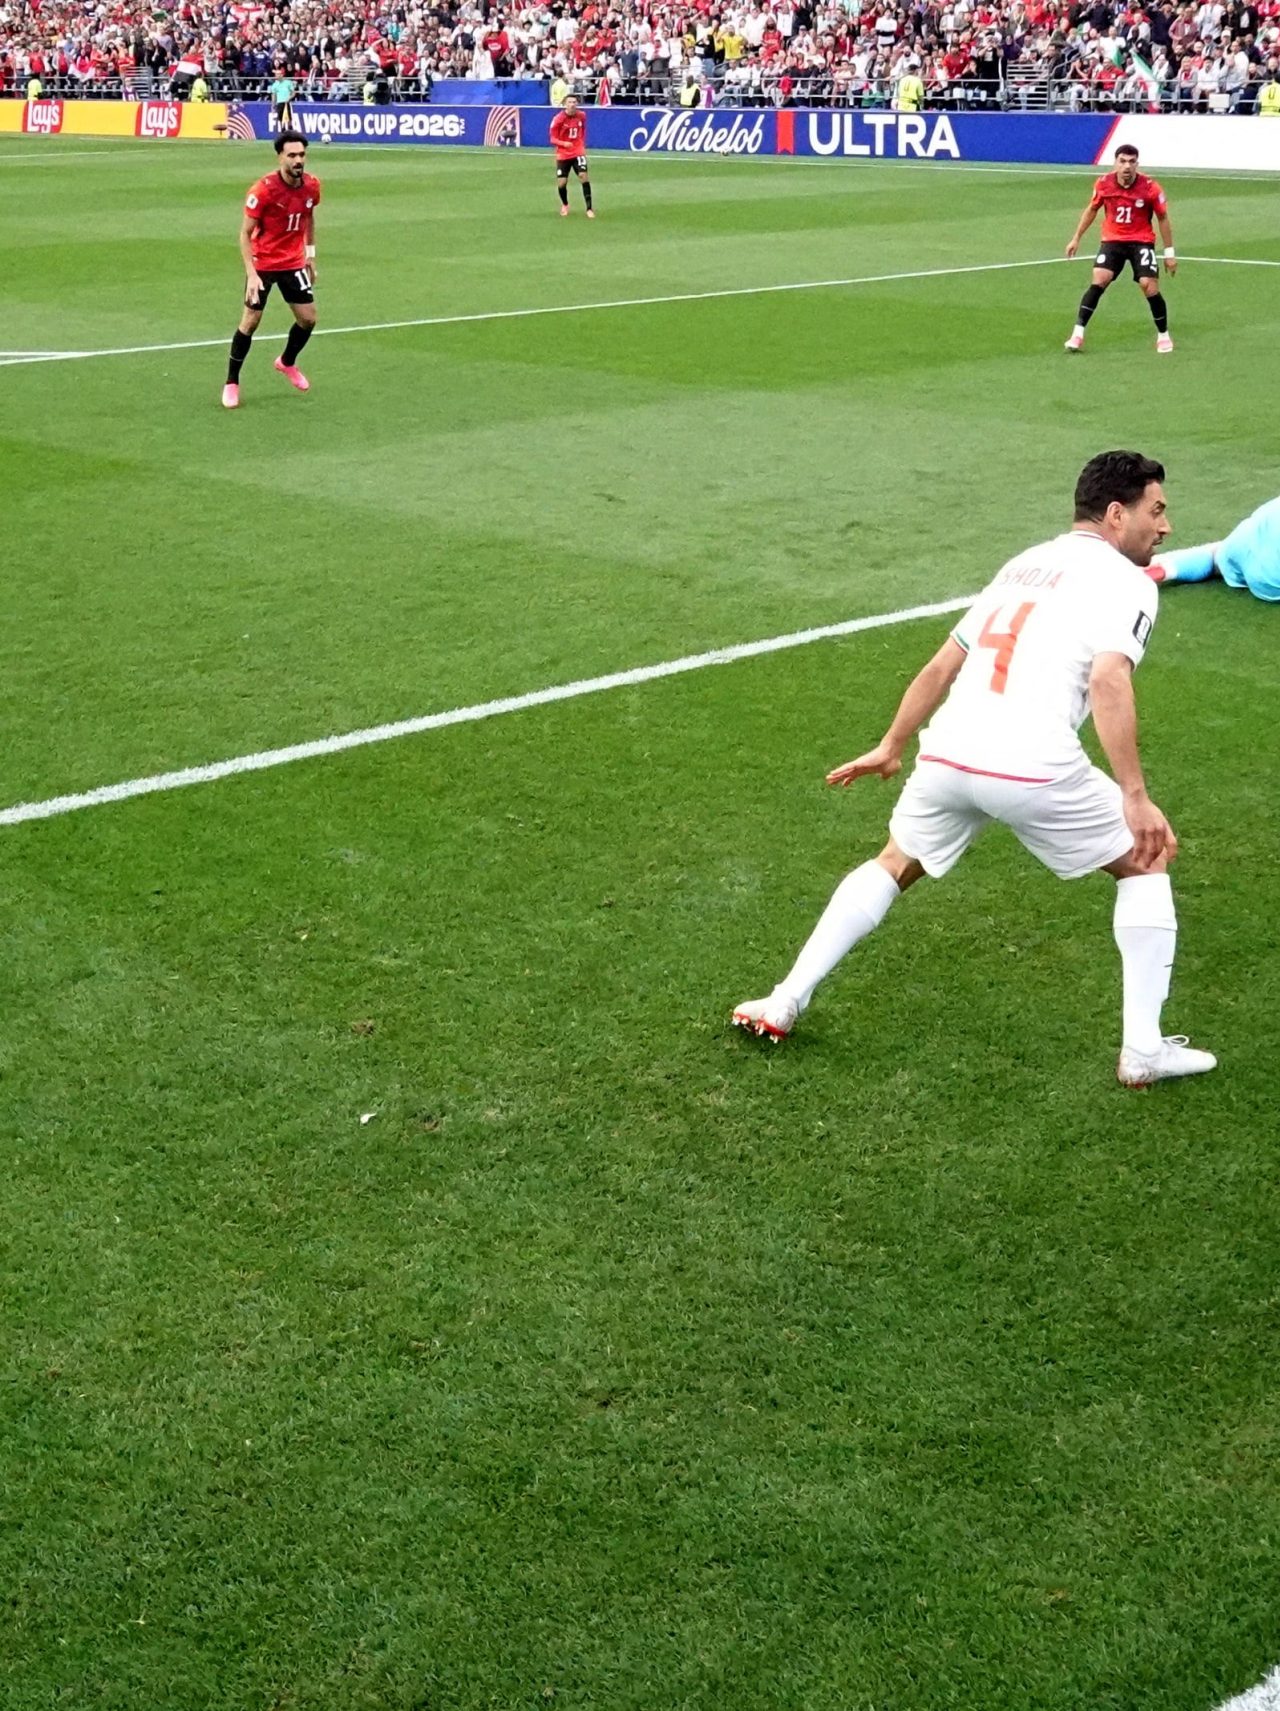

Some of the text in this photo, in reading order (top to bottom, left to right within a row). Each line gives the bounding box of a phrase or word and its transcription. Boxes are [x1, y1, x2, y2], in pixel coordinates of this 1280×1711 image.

[27, 101, 60, 133] Lay's
[141, 101, 179, 137] Lay's
[268, 112, 303, 133] FA
[303, 113, 363, 135] WORLD
[363, 114, 397, 135] CUP
[399, 114, 460, 137] 2026
[630, 108, 961, 158] Michelob ULTRA
[286, 212, 301, 231] 11
[1115, 206, 1132, 224] 21
[1140, 248, 1157, 266] 21
[295, 268, 312, 291] 11
[1001, 567, 1064, 590] SHOJA
[977, 602, 1037, 695] 4
